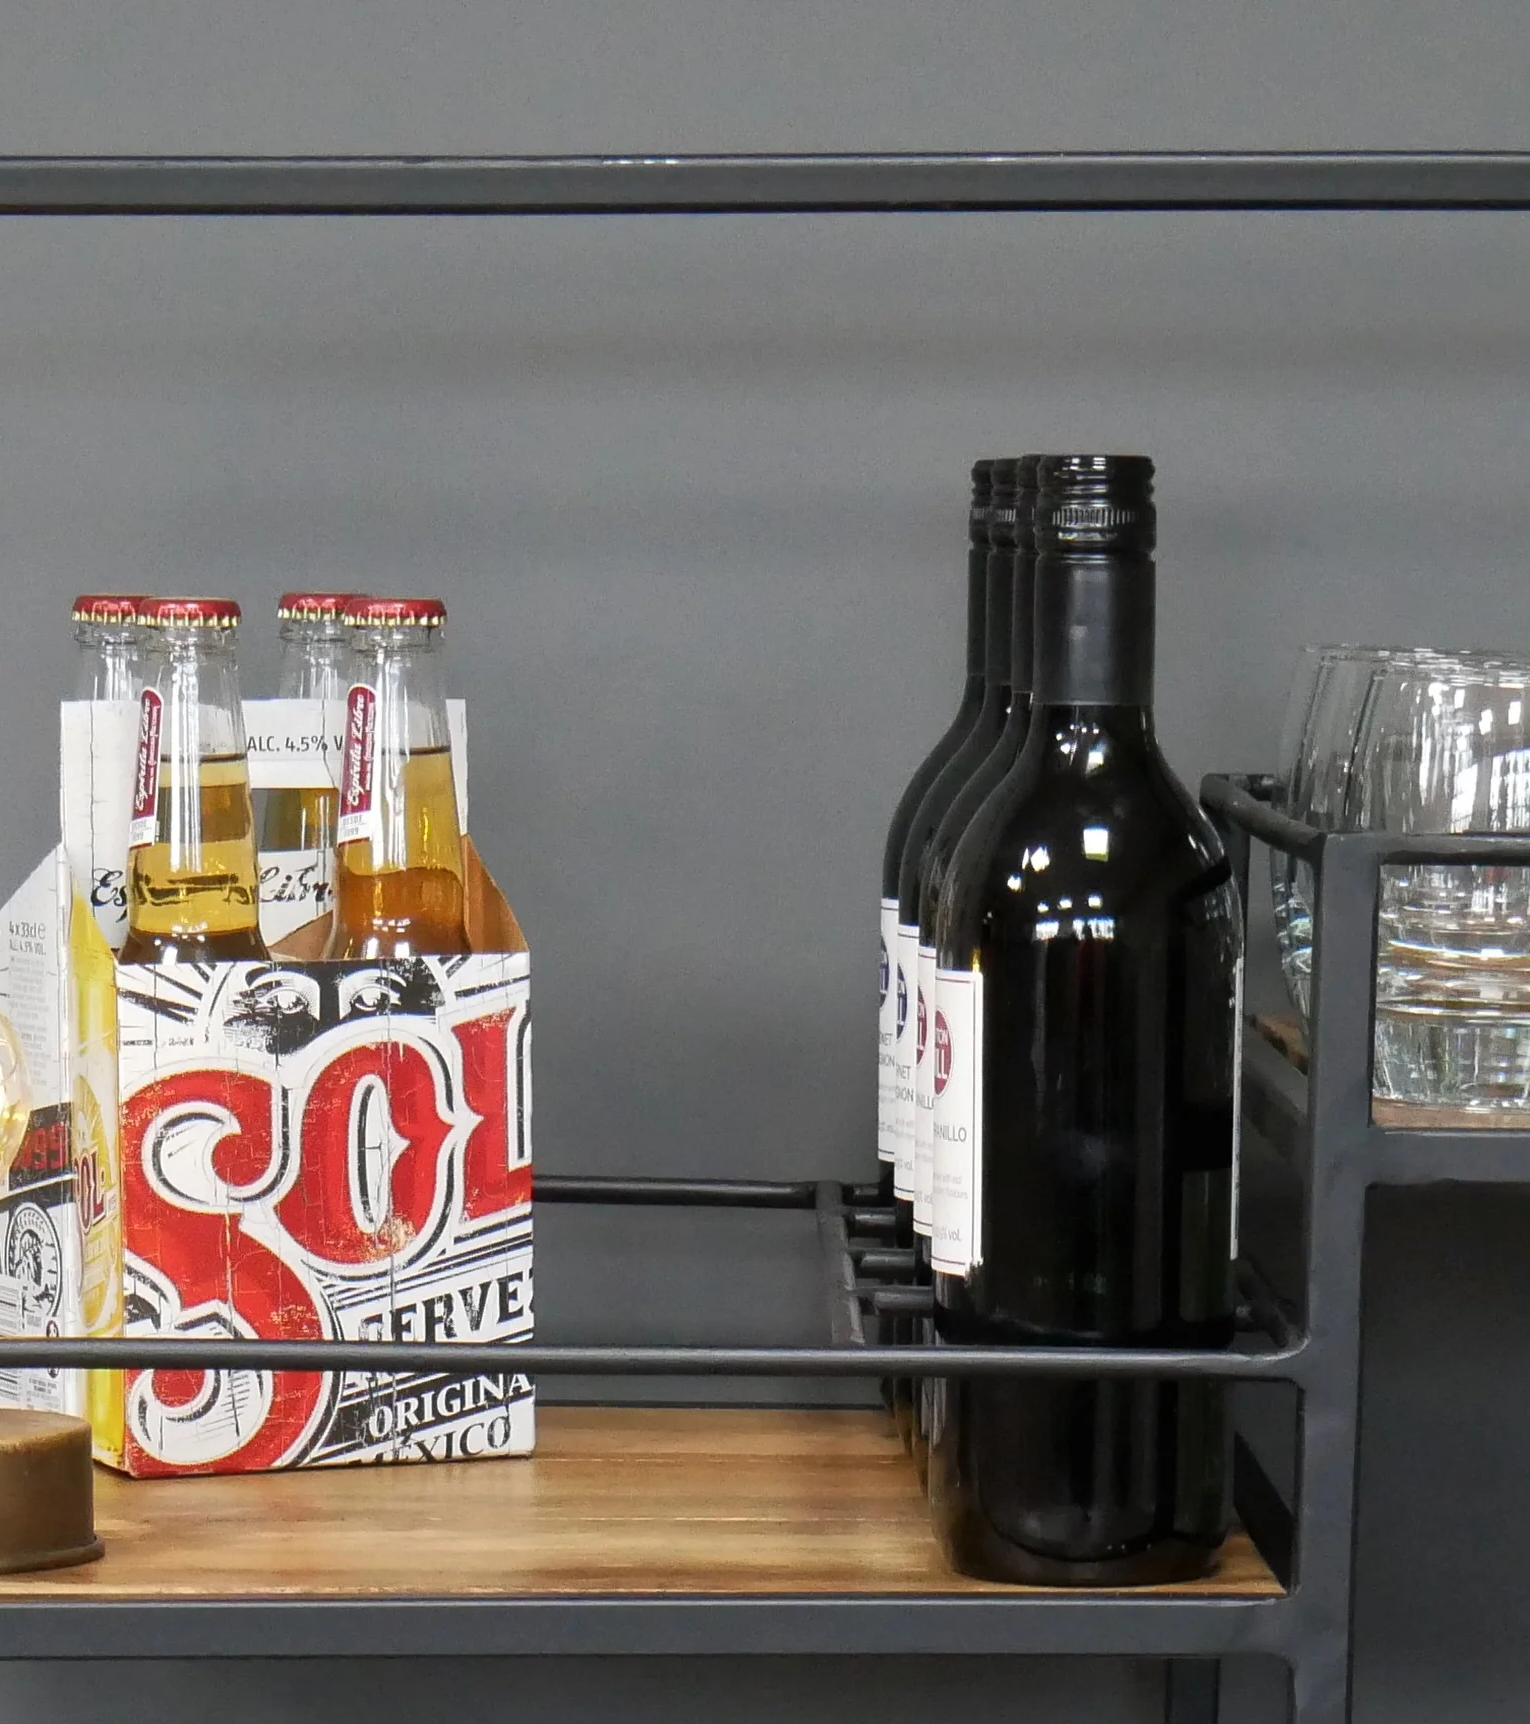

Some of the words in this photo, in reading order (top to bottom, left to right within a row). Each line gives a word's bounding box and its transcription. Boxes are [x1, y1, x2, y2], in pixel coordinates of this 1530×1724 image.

[247, 735, 280, 752] ALC.
[285, 735, 328, 752] 4.5%
[119, 1005, 534, 1478] SOL
